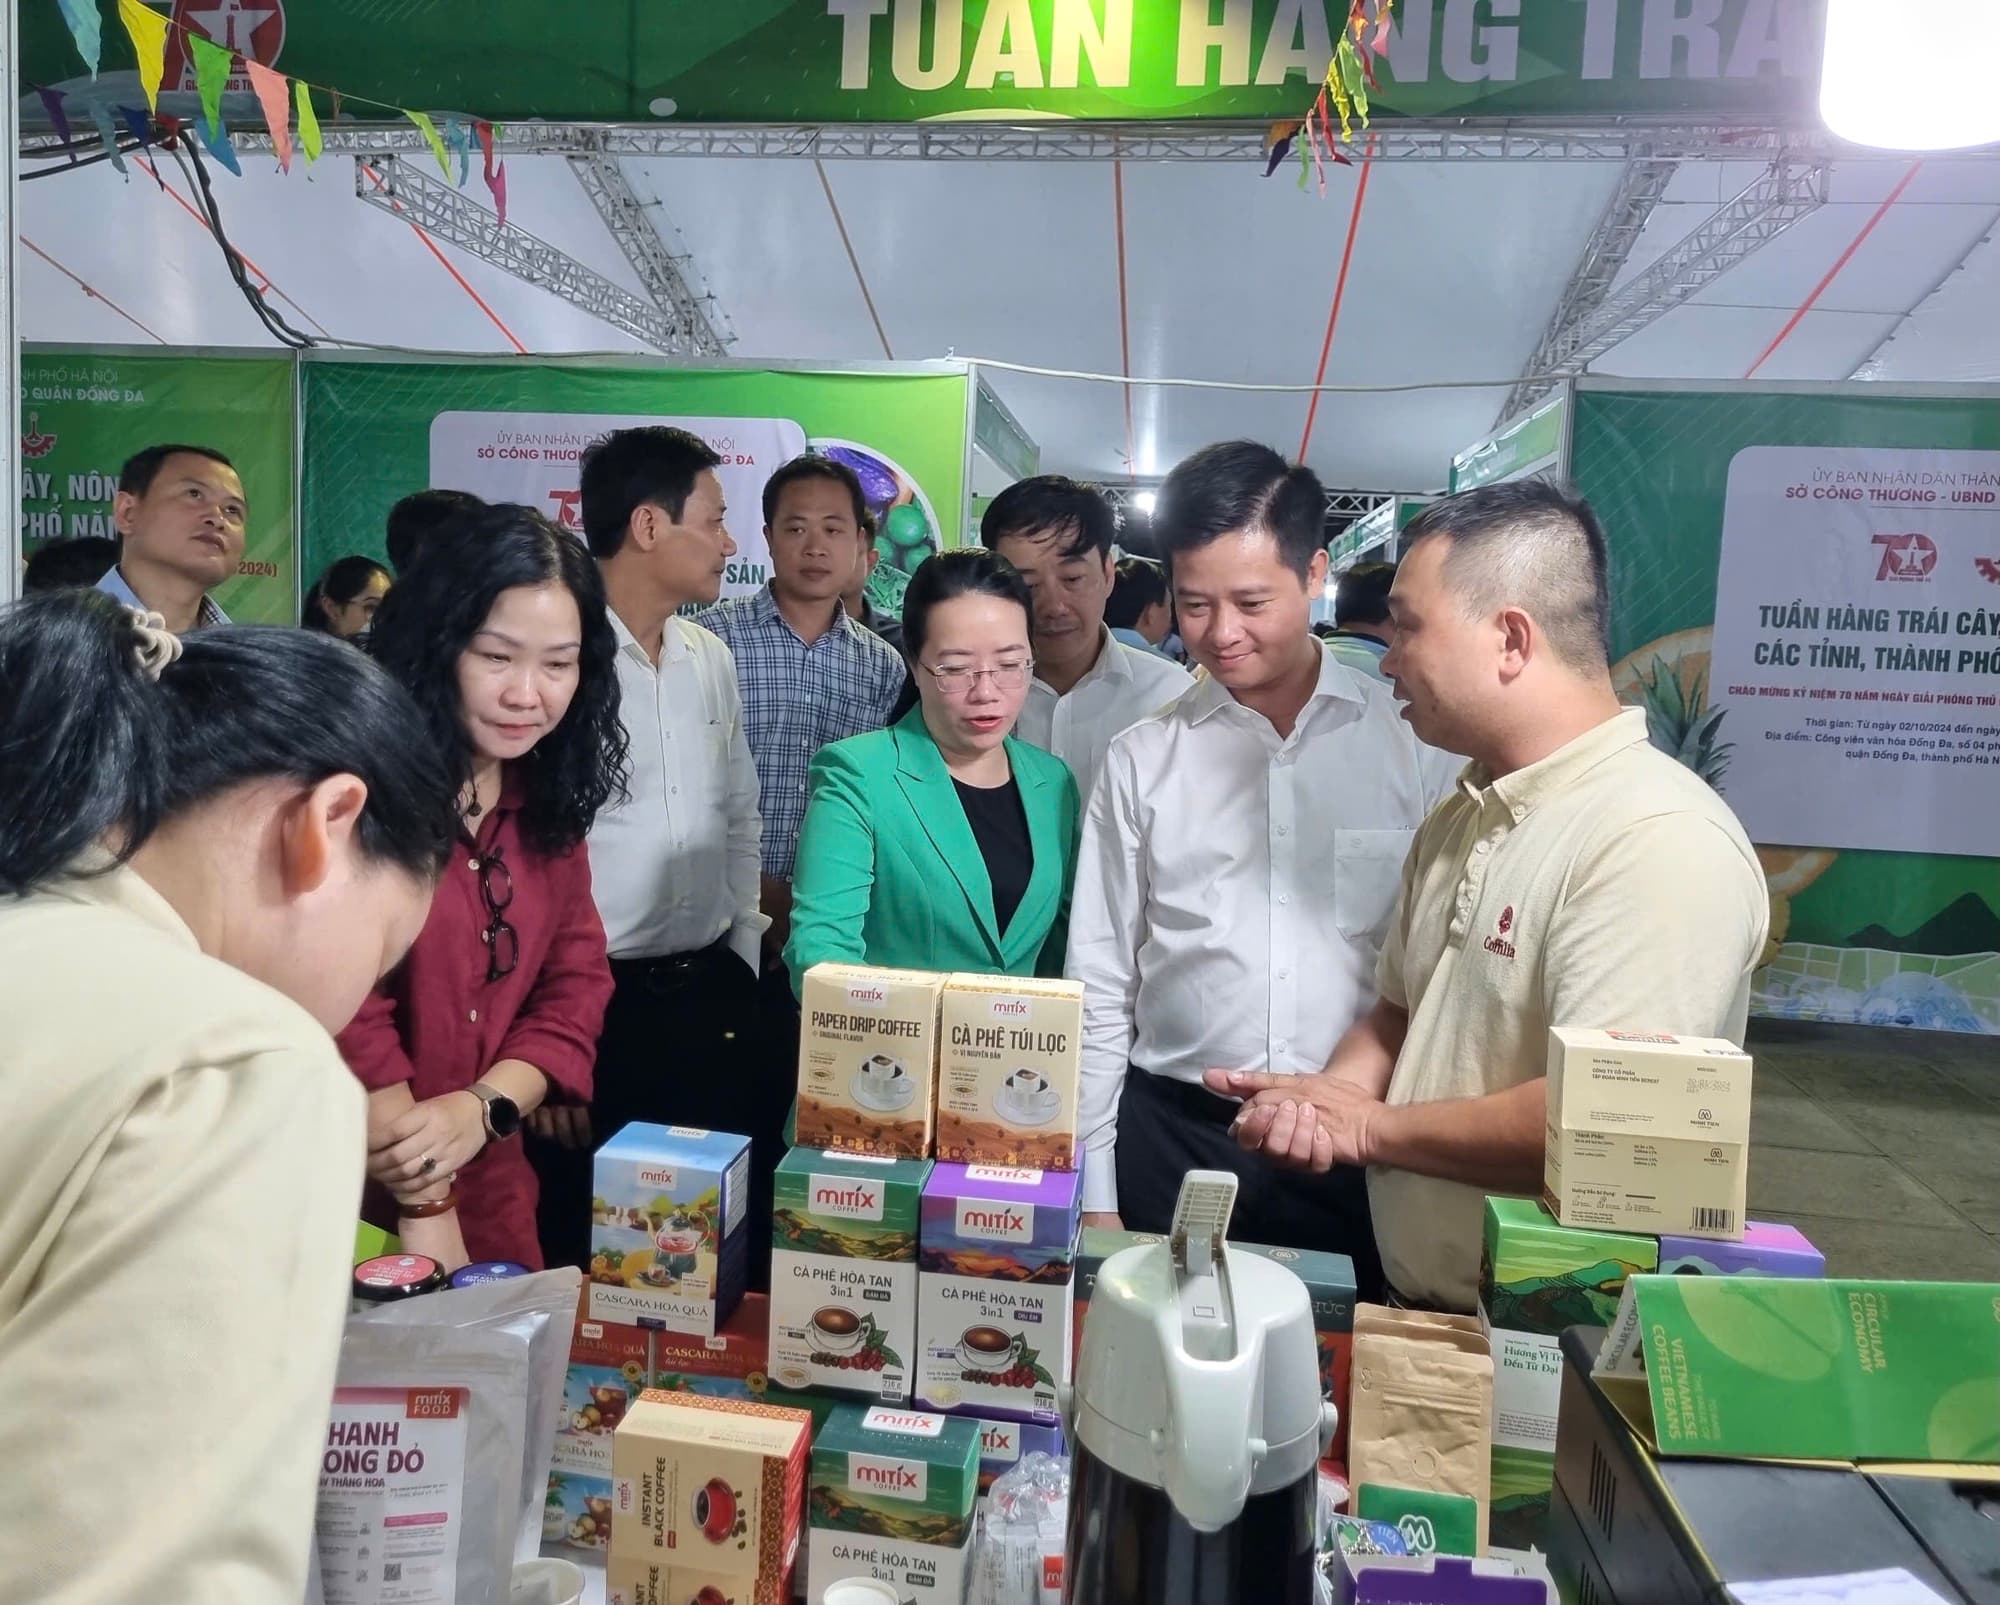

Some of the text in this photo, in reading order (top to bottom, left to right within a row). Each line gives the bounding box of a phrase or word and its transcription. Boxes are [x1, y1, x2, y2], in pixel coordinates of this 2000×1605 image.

[32, 387, 72, 405] QUẬN
[124, 389, 145, 402] ĐA
[515, 434, 542, 446] BAN
[544, 433, 581, 446] NHÂN
[477, 446, 495, 459] SỞ
[499, 447, 539, 460] CÔNG
[736, 454, 754, 466] ĐA
[1813, 467, 1833, 482] ỦY
[1836, 471, 1868, 483] BAN
[1872, 470, 1917, 485] NHÂN
[1921, 470, 1957, 486] DÂN
[1786, 483, 1996, 505] SỞ CÔNG THƯƠNG UBND
[726, 557, 766, 585] SẢN
[1759, 598, 1820, 629] TUẦN
[1826, 603, 1890, 633] HÀNG
[1897, 606, 1949, 635] TRÁI
[1754, 638, 1801, 667] CÁC
[1808, 637, 1866, 672] TỈNH,
[1875, 643, 1951, 673] THÀNH
[1728, 684, 1757, 697] CHÀO
[1759, 684, 1790, 698] MỪNG
[1810, 687, 1836, 701] NIỆM
[1838, 688, 1852, 700] 70
[1854, 688, 1879, 701] NĂM
[1881, 690, 1909, 703] NGÀY
[1912, 690, 1934, 703] GIẢI
[1937, 692, 1973, 705] PHÓNG
[1976, 693, 1996, 706] THỦ
[1805, 718, 1827, 728] Thời
[1872, 721, 1896, 732] ngày
[1899, 721, 1951, 733] 02/10/2024
[1954, 723, 1973, 734] đến
[1765, 731, 1783, 743] Địa
[1815, 732, 1841, 745] Công
[1844, 734, 1864, 745] viên
[1867, 735, 1885, 745] văn
[1888, 736, 1906, 746] hóa
[1973, 740, 1985, 750] 04
[1846, 749, 1870, 761] quận
[1921, 752, 1950, 763] thành
[1976, 755, 1989, 764] Hà
[812, 1011, 921, 1038] PAPER DRIP COFFEE
[952, 1023, 1066, 1057] CÀ PHÊ TÚI LỌC
[832, 1204, 859, 1213] COFFEE
[980, 1226, 1008, 1236] COFFEE
[793, 1265, 892, 1288] CÀ PHÊ HÒA TAN
[830, 1285, 853, 1298] 3in1
[942, 1286, 1044, 1310] CÀ PHÊ HÒA TAN
[595, 1292, 708, 1317] CASCARA HOA QUẢ
[980, 1304, 1004, 1318] 3in1
[1849, 1292, 1874, 1374] ECONOMY
[1864, 1292, 1887, 1369] CIRCULAR
[665, 1345, 719, 1361] CASCARA
[1504, 1345, 1549, 1362] Hương Vị
[1504, 1357, 1523, 1369] Đến
[1542, 1363, 1558, 1376] Đại
[1652, 1324, 1681, 1440] COFFEE BEANS
[1671, 1337, 1699, 1440] VIETNAMESE
[414, 1405, 450, 1415] FOOD
[387, 1442, 424, 1474] ĐỎ
[365, 1477, 385, 1488] HOA
[873, 1482, 901, 1491] COFFEE
[642, 1472, 652, 1526] INSTANT
[654, 1456, 666, 1547] BLACK COFFEE
[832, 1545, 937, 1573] CÀ PHÊ HÒA TAN
[871, 1568, 896, 1582] 3in1
